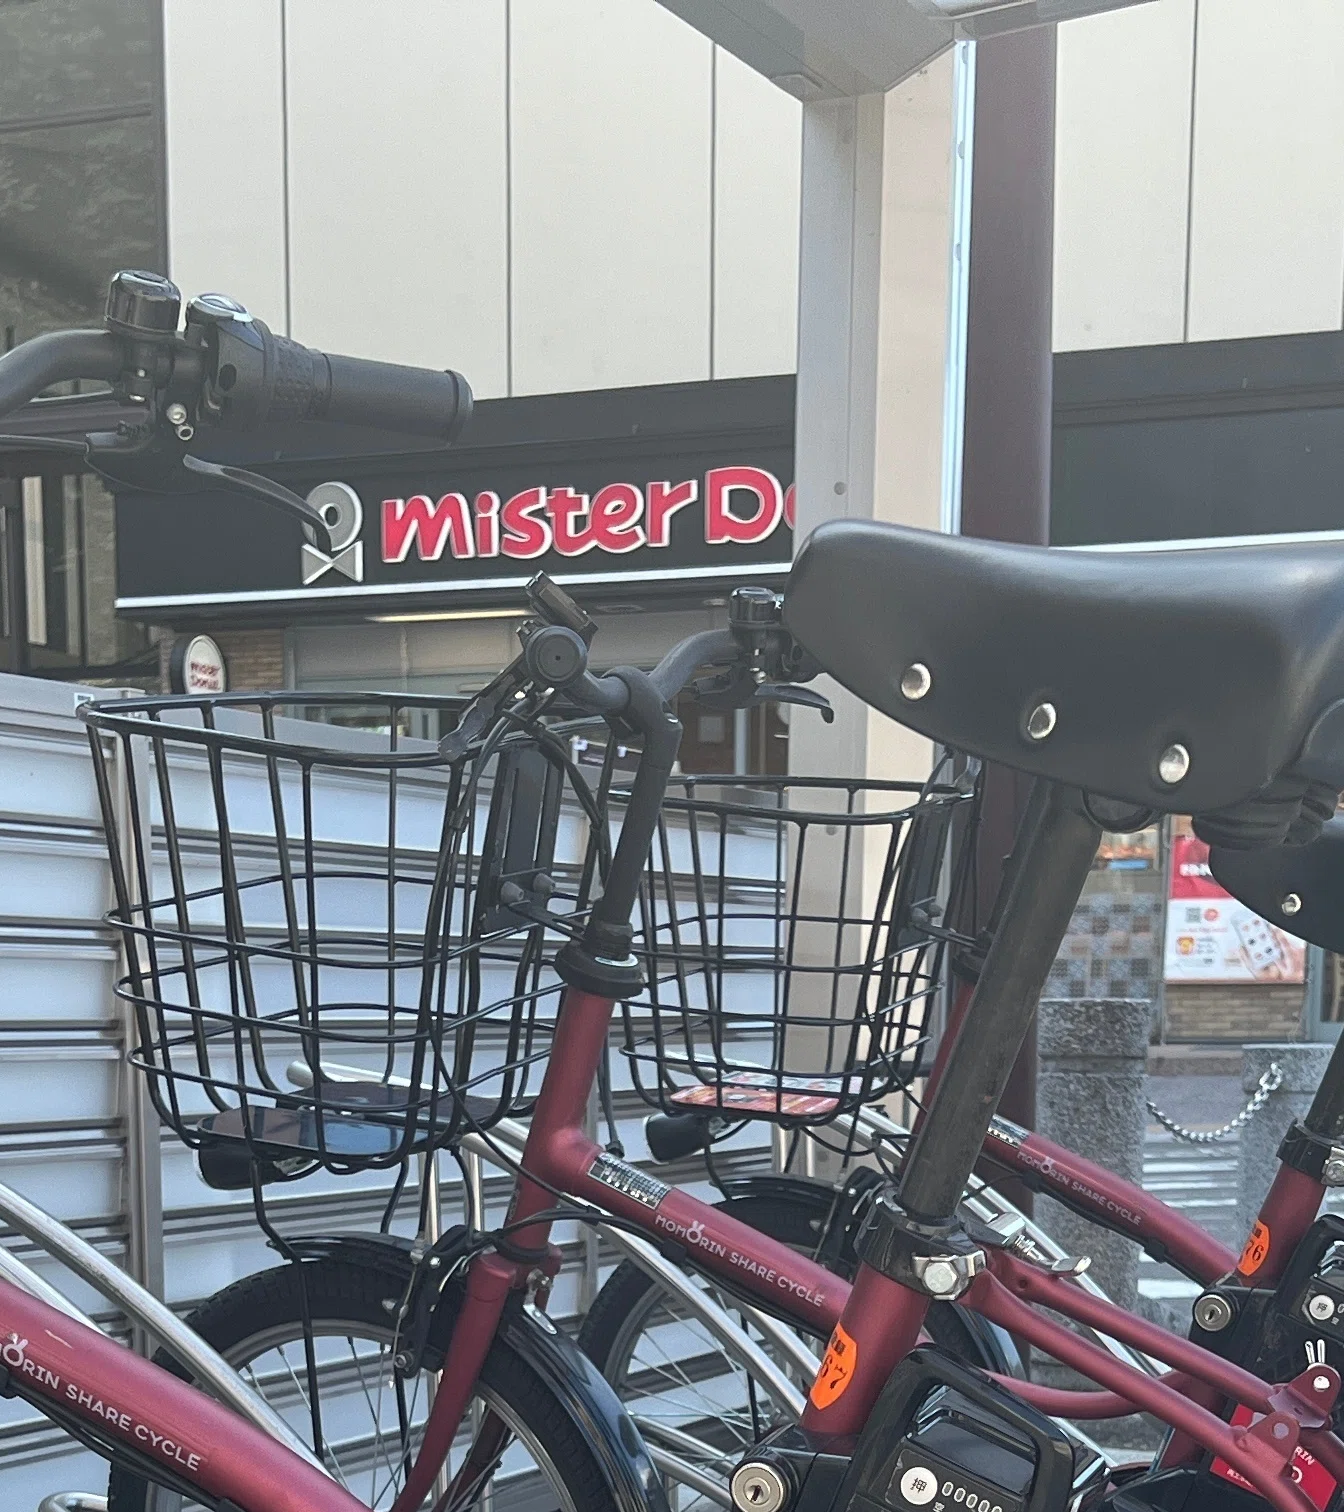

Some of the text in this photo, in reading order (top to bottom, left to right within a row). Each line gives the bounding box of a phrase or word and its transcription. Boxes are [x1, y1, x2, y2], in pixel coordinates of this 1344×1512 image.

[704, 466, 793, 544] D
[1071, 1181, 1107, 1206] SHARE
[1107, 1201, 1143, 1226] CYCLE
[655, 1212, 826, 1307] MOMORIN SHARE CYCLE
[66, 1384, 131, 1432] SHARE
[134, 1424, 201, 1471] CYCLE
[910, 1477, 927, 1494] 押
